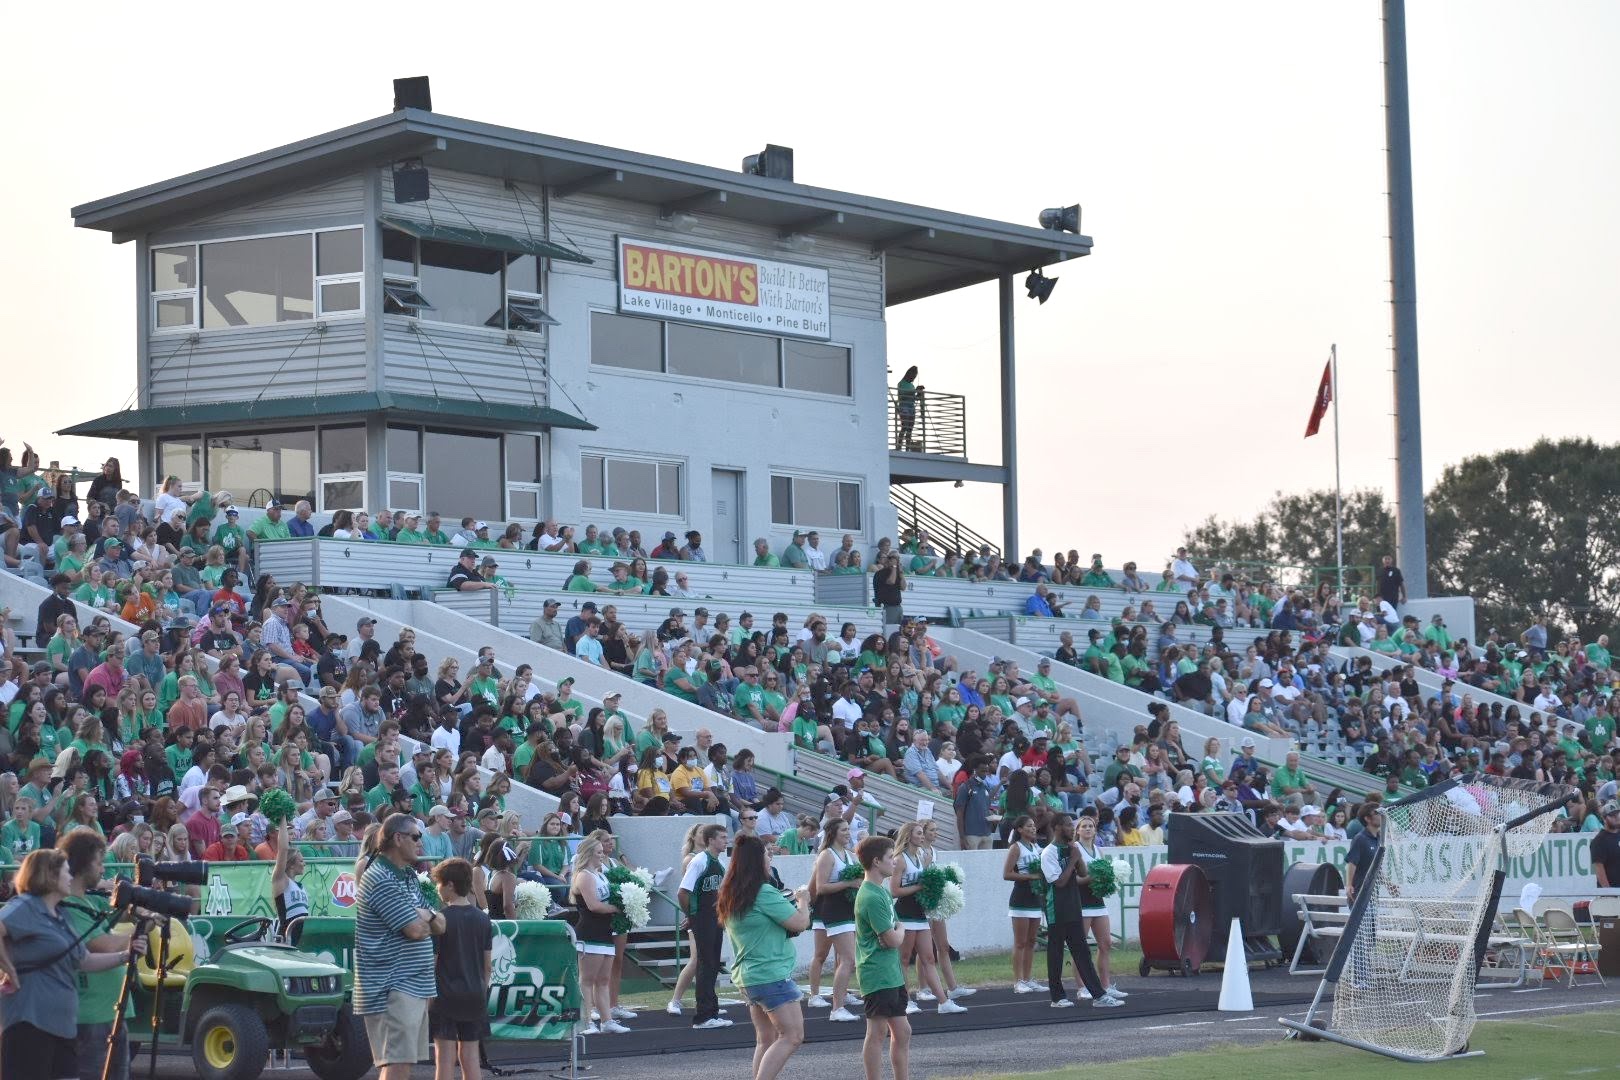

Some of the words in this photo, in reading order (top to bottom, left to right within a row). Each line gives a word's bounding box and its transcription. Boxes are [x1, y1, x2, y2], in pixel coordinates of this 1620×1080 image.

[626, 249, 759, 304] BARTON'S
[759, 266, 786, 287] Build
[788, 273, 797, 288] It
[798, 273, 827, 293] Better
[623, 294, 651, 308] Lake
[654, 297, 692, 315] Village
[706, 306, 763, 325] Monticello
[776, 315, 799, 329] Pine
[802, 319, 827, 333] Bluff
[759, 288, 783, 308] With
[784, 292, 824, 315] Barton's
[344, 547, 351, 559] 6
[526, 558, 532, 570] 8
